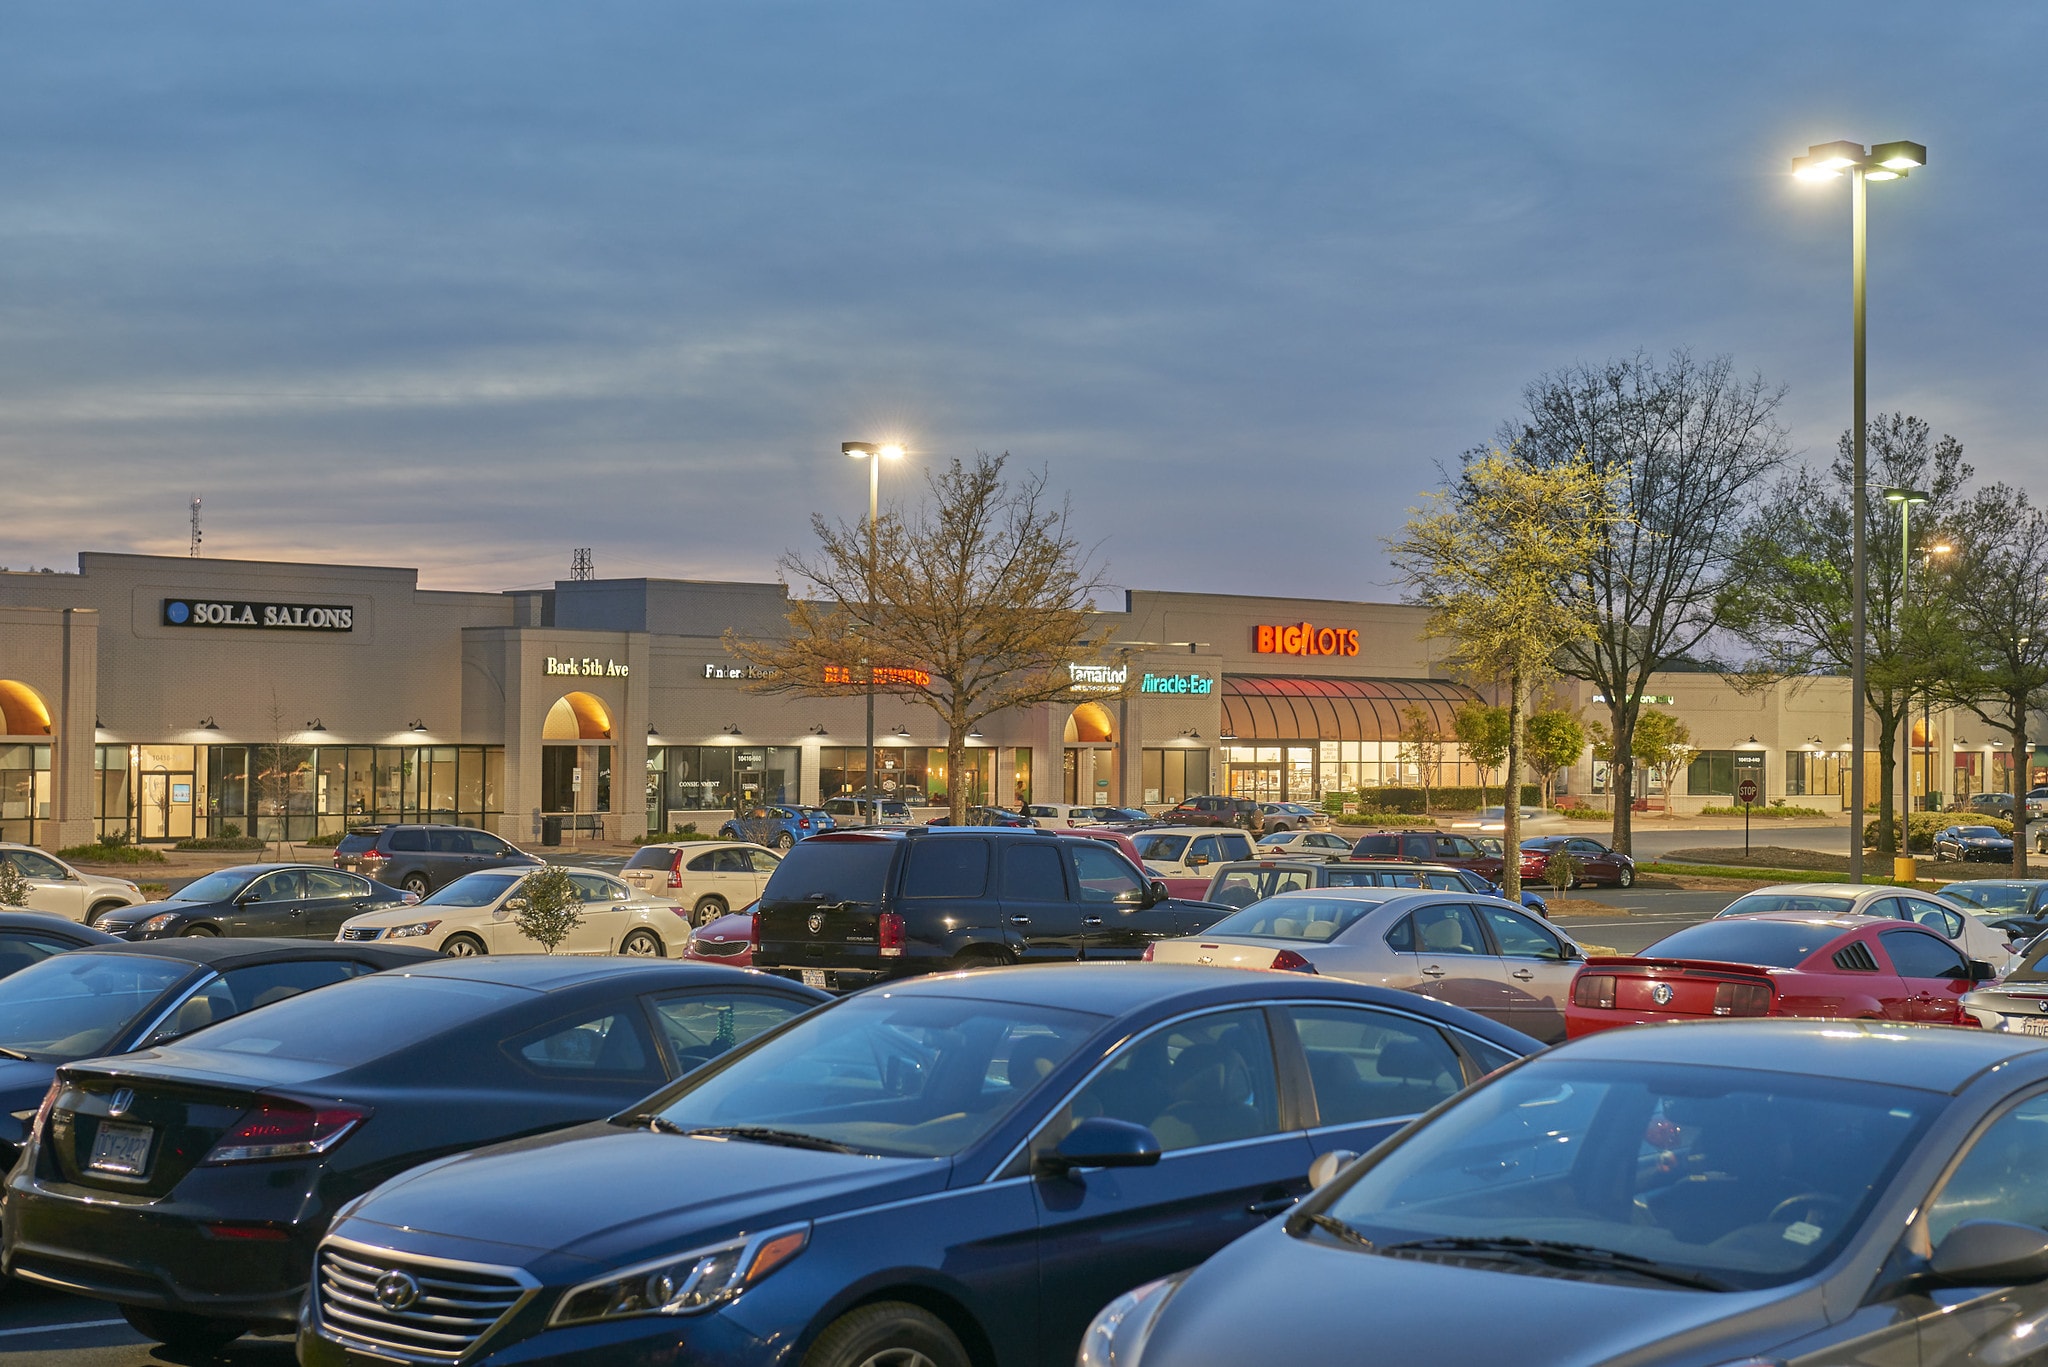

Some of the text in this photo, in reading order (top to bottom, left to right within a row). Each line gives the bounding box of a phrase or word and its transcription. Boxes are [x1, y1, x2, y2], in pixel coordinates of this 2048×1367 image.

[193, 603, 352, 628] SOLA SALONS
[547, 657, 629, 677] Bark 5th Ave
[705, 664, 745, 679] Finders
[1740, 786, 1756, 796] STOP
